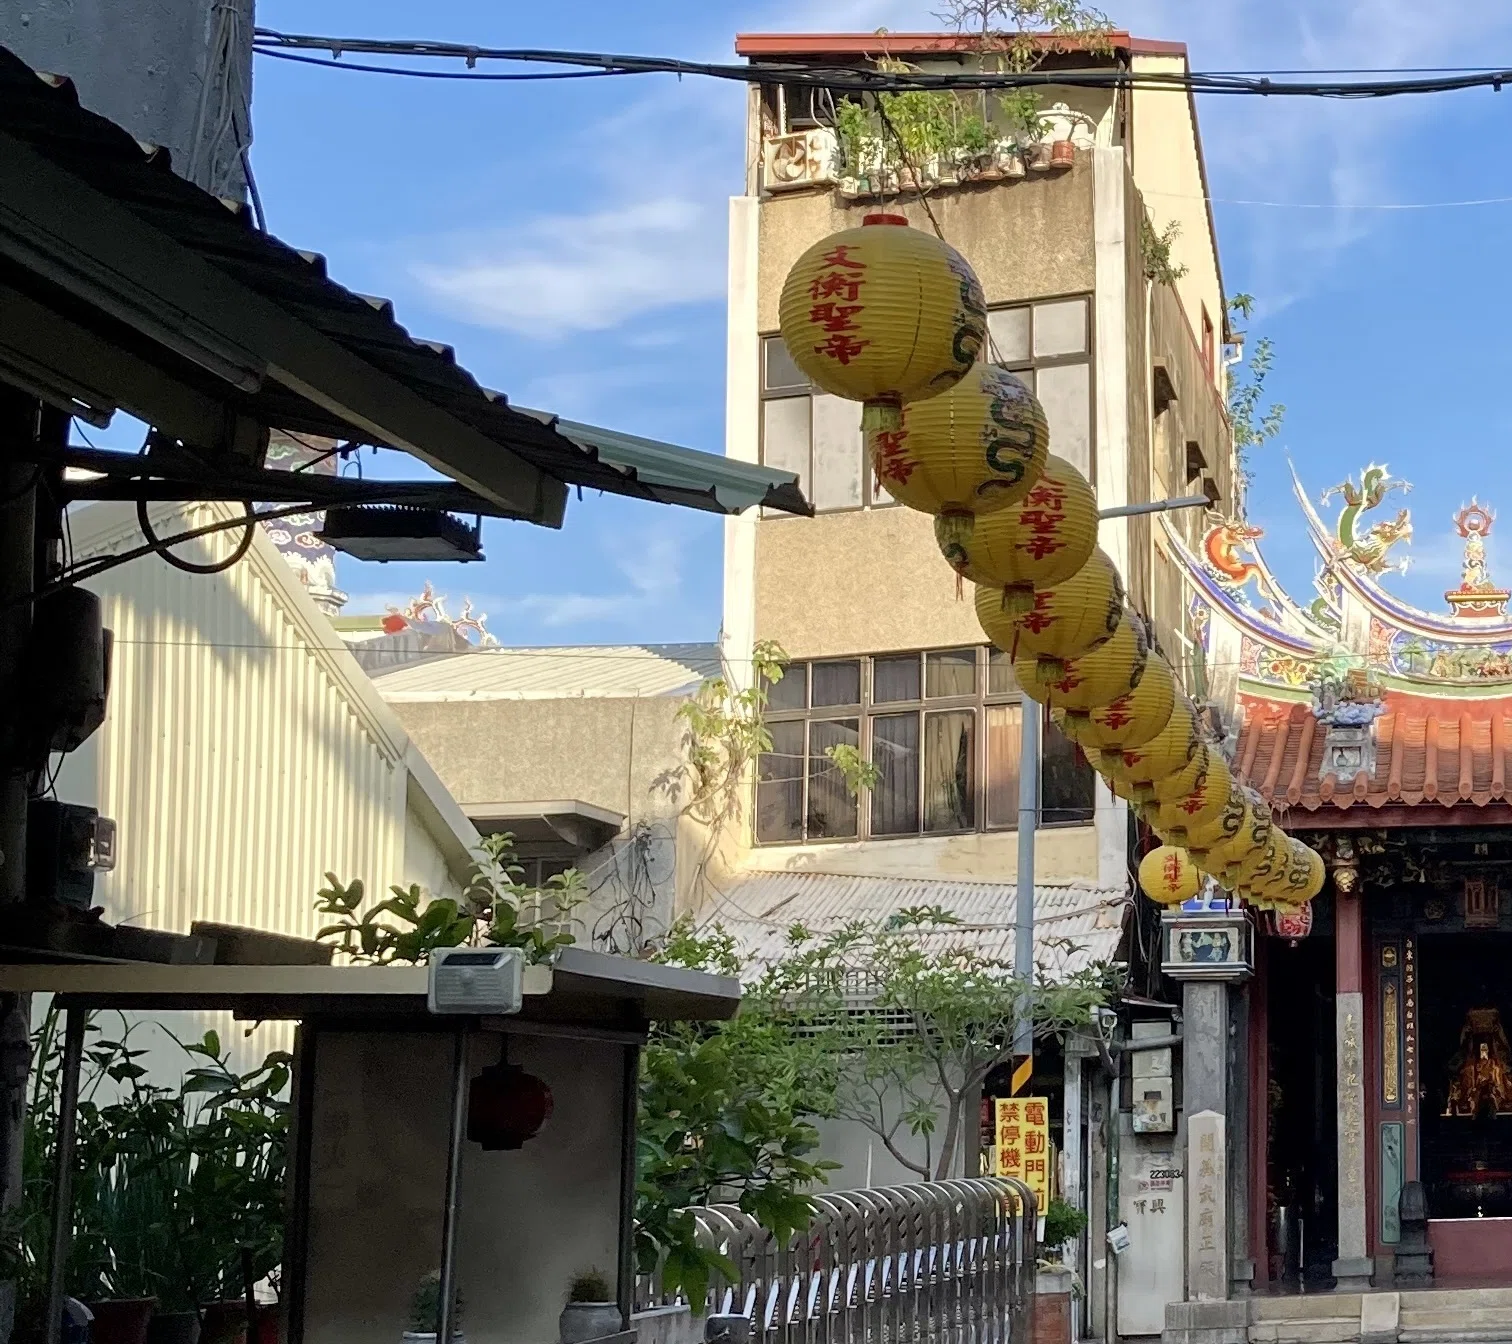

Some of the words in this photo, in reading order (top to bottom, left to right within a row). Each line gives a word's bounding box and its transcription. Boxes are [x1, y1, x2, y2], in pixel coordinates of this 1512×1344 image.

[807, 244, 871, 365] 文衡聖帝
[875, 406, 923, 486] 聖帝
[999, 1102, 1021, 1212] 禁停機
